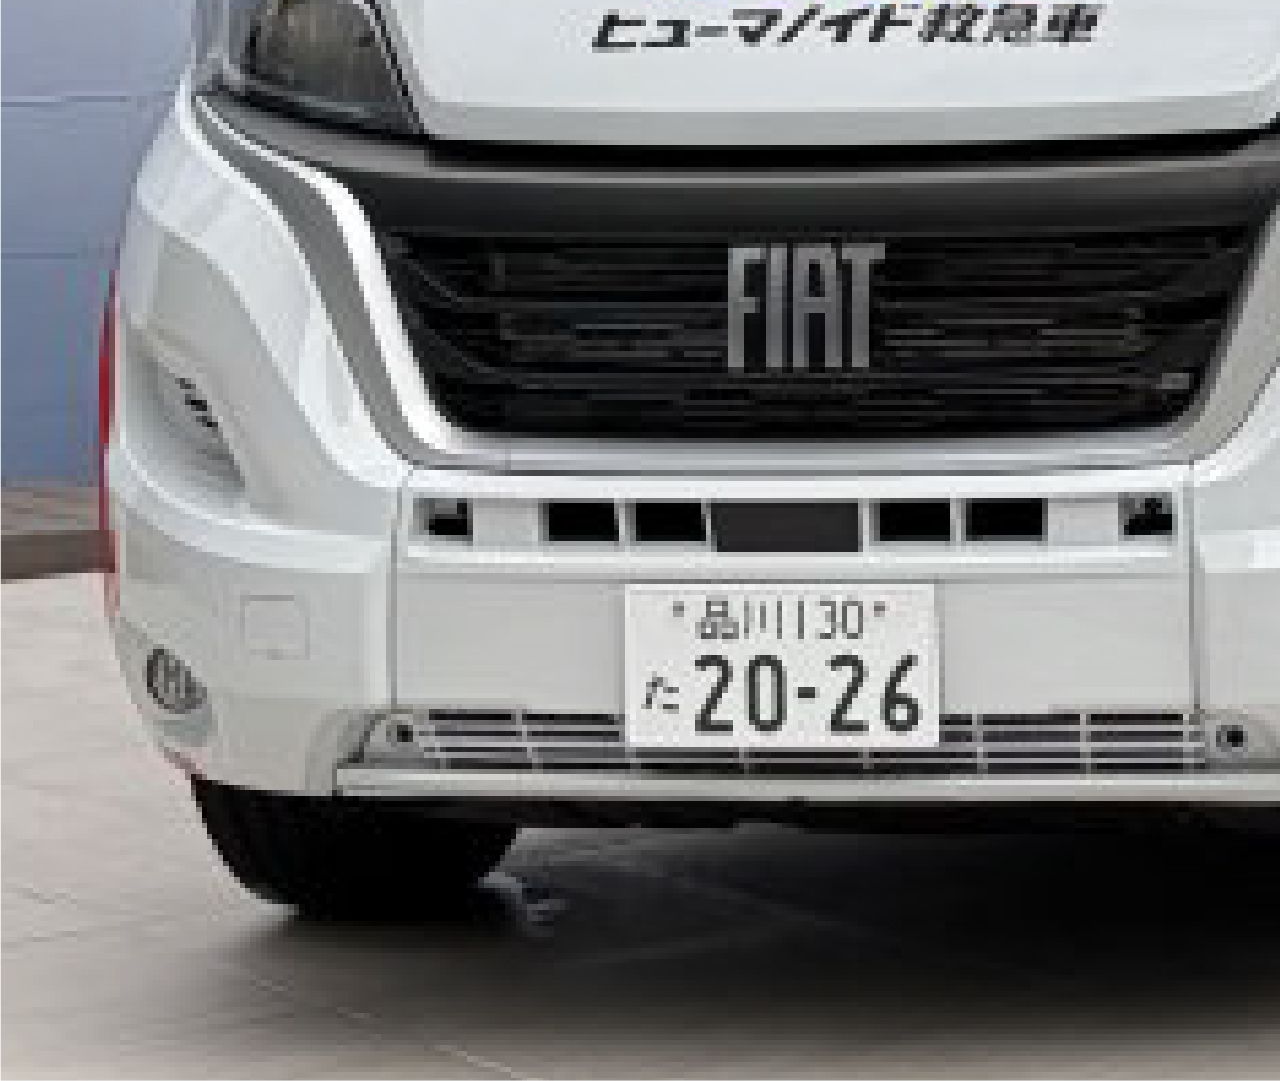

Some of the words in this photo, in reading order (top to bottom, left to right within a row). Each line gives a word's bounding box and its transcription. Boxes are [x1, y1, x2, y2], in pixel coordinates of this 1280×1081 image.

[592, 1, 1103, 52] ヒューマノイド救急車
[726, 242, 887, 370] FIAT
[694, 653, 921, 733] 20-26
